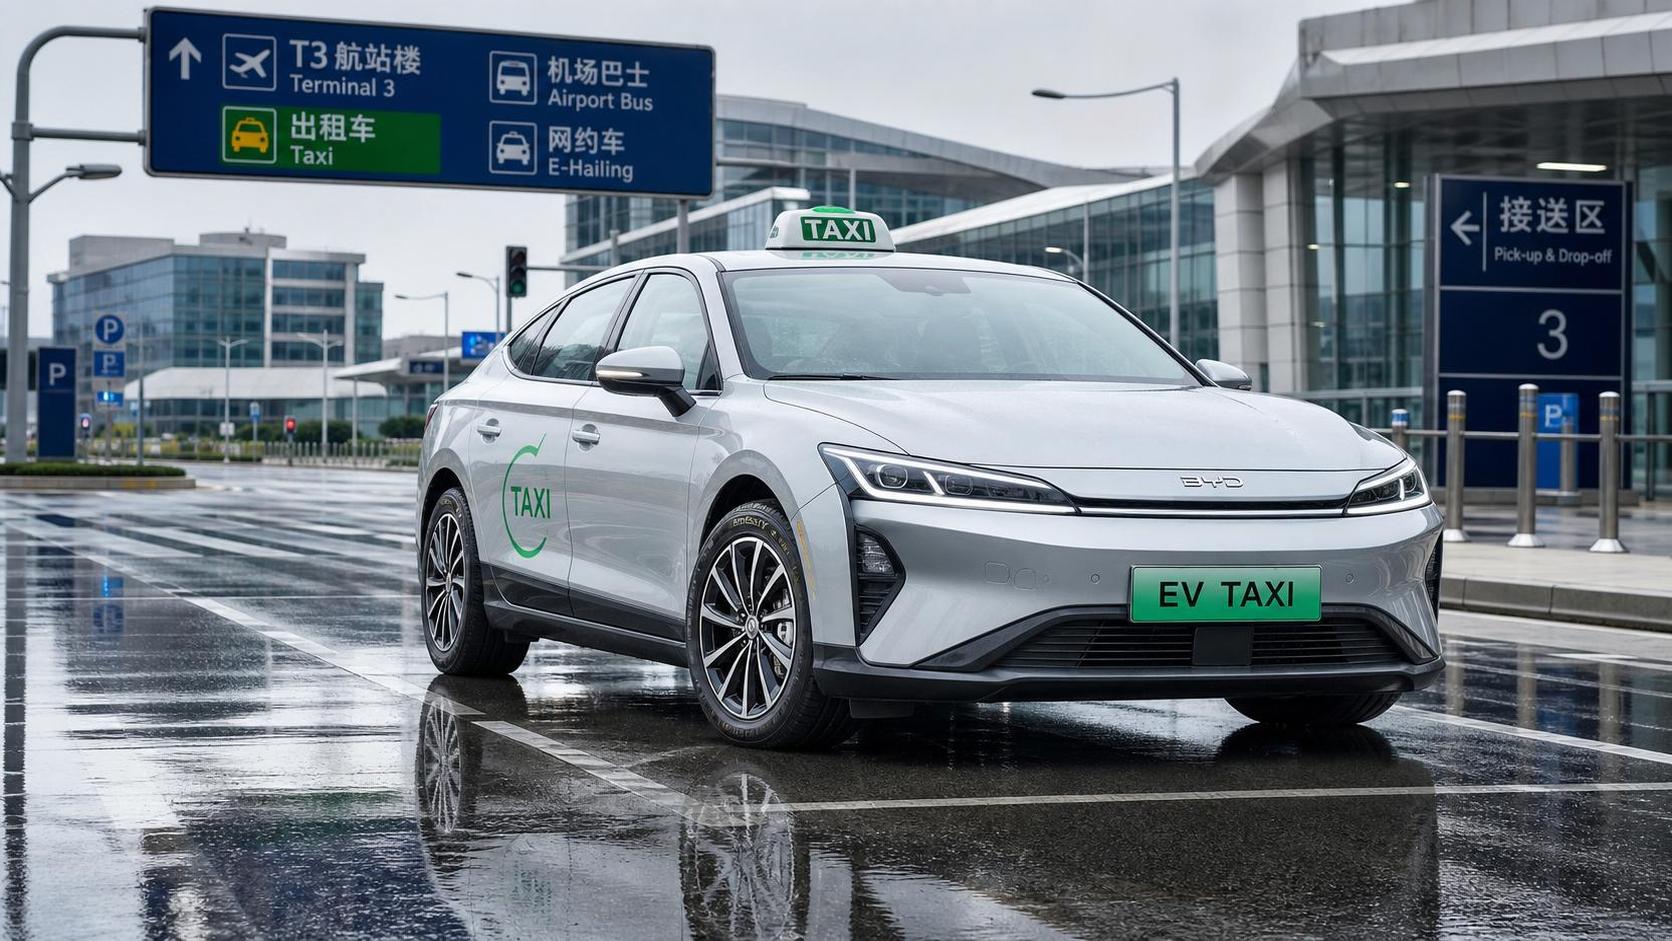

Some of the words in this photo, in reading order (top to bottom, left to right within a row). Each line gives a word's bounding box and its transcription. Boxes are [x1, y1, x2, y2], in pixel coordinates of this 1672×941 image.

[289, 39, 328, 69] T3
[334, 41, 421, 75] 航站楼
[548, 55, 650, 88] 机场巴士
[290, 74, 376, 97] Terminal
[383, 79, 396, 97] 3
[548, 89, 615, 111] Airport
[620, 93, 654, 111] Bus
[291, 111, 376, 142] 出租车
[548, 126, 625, 155] 网约车
[290, 145, 333, 165] Taxi
[548, 158, 633, 182] E-Hailing
[1500, 195, 1605, 234] 接送区
[804, 219, 872, 241] TAXI
[1494, 247, 1543, 265] Pick-up
[1545, 249, 1556, 262] &
[1559, 249, 1613, 266] Drop-off
[103, 318, 119, 341] P
[1537, 309, 1569, 360] 3
[49, 362, 66, 386] P
[103, 354, 117, 374] P
[1545, 404, 1562, 428] P
[1180, 476, 1244, 488] BYD
[510, 486, 551, 519] TAXI
[1159, 581, 1204, 608] EV
[1221, 581, 1294, 608] TAXI
